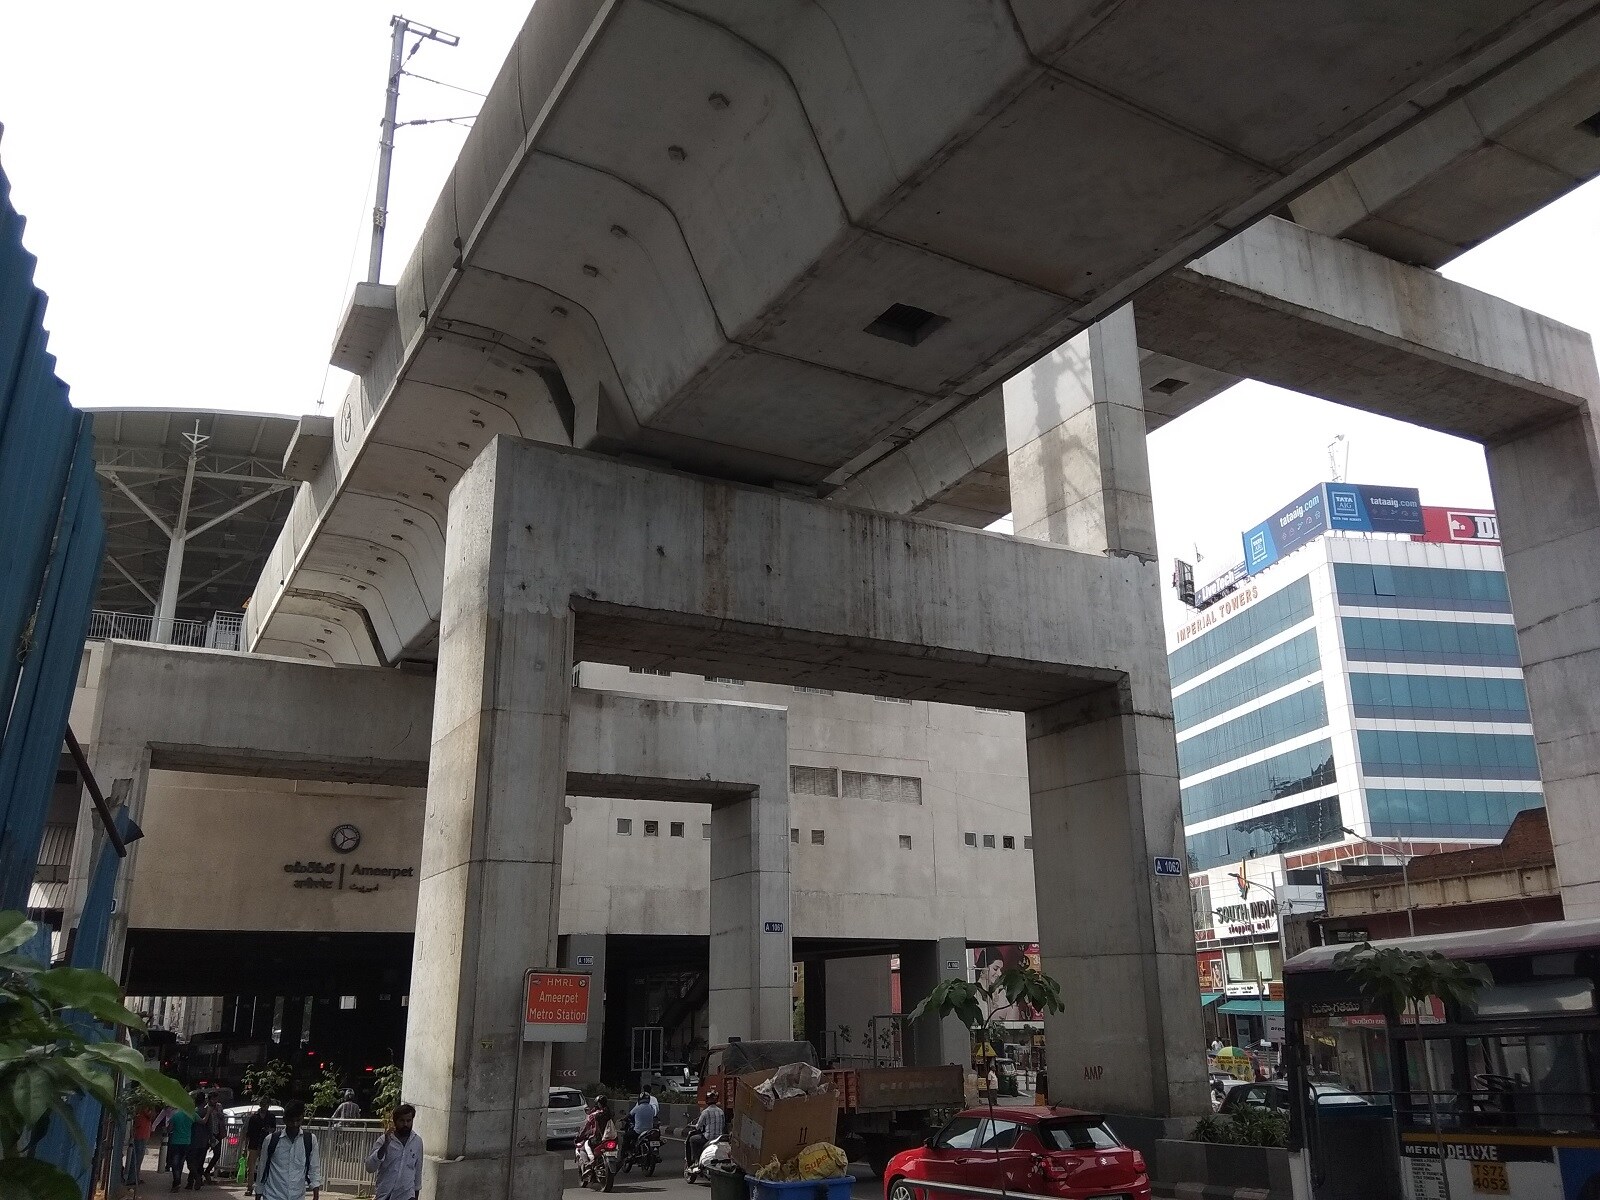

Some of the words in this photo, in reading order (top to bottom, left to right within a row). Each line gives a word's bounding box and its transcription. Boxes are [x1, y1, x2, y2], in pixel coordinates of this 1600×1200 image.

[1370, 496, 1418, 509] tataaig.com
[1279, 495, 1320, 528] tataaig.com
[1177, 611, 1217, 643] IMPERIAL
[1219, 586, 1259, 618] TOWERS
[351, 864, 414, 879] Ameerpet
[1156, 861, 1163, 871] A
[1164, 861, 1180, 873] 1062
[1216, 904, 1250, 924] SOUTH
[1250, 899, 1278, 919] INDIA
[1228, 923, 1255, 934] shopping
[1257, 919, 1271, 930] mall
[547, 978, 574, 987] HMRL
[539, 990, 579, 1005] Ameerpet
[529, 1008, 554, 1020] Metro
[556, 1008, 586, 1021] Station
[1084, 1065, 1104, 1080] AMP
[1446, 1144, 1498, 1161] DELUXE
[1473, 1177, 1509, 1192] 4052
